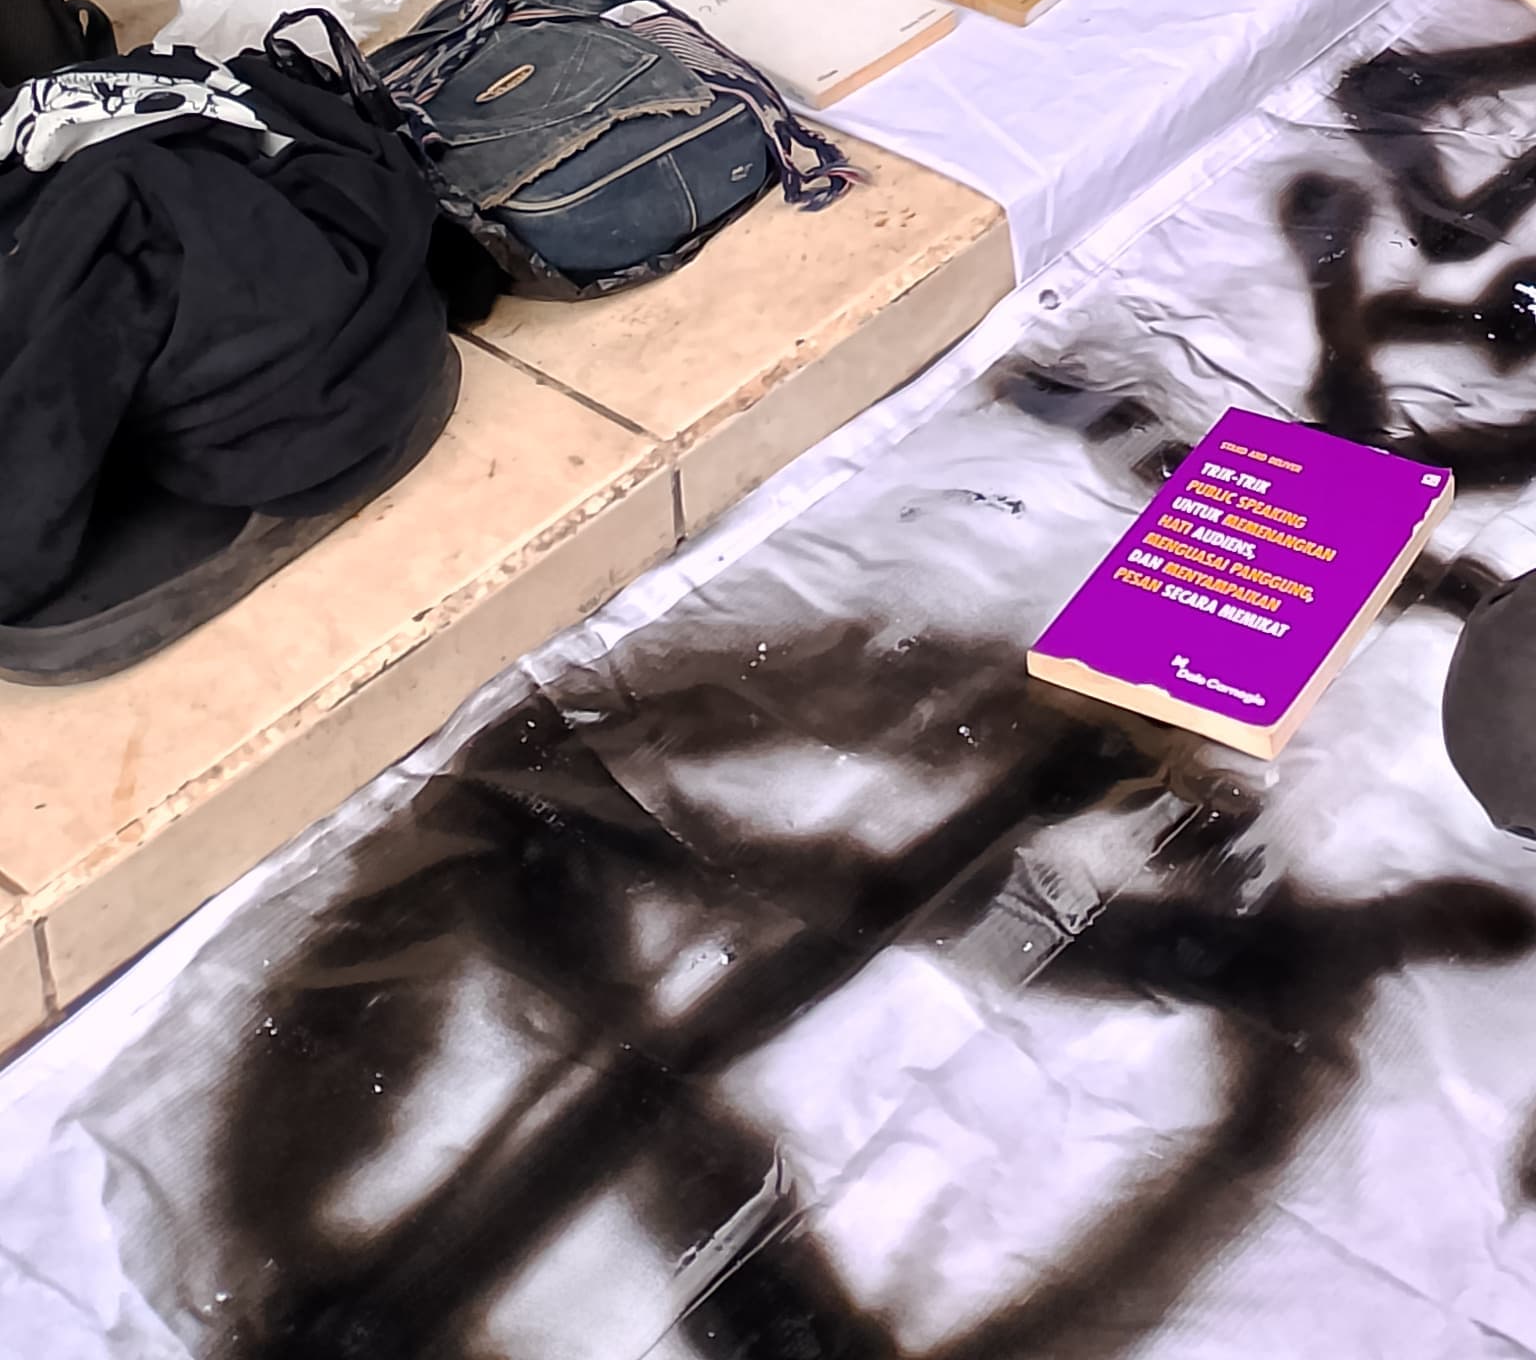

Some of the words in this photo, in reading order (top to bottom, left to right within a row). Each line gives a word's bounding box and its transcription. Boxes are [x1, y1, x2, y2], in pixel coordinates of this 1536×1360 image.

[1186, 479, 1238, 505] PUBLIC
[1236, 496, 1308, 529] SPEAKING
[1200, 462, 1272, 494] TRIK-TRIK
[1157, 514, 1194, 536] HATI
[1191, 526, 1257, 560] AUDIENS,
[1171, 496, 1224, 523] UNTUK
[1221, 514, 1337, 562] MEMENANGKAN
[1127, 548, 1165, 571] DAN
[1161, 562, 1282, 613] MENYAMPAIKAN
[1142, 532, 1231, 571] MENGUASAI
[1229, 562, 1315, 603] PANGGUNG,
[1113, 567, 1164, 593] PESAN
[1161, 583, 1219, 614] SECARA
[1218, 604, 1291, 638] MEMIKAT
